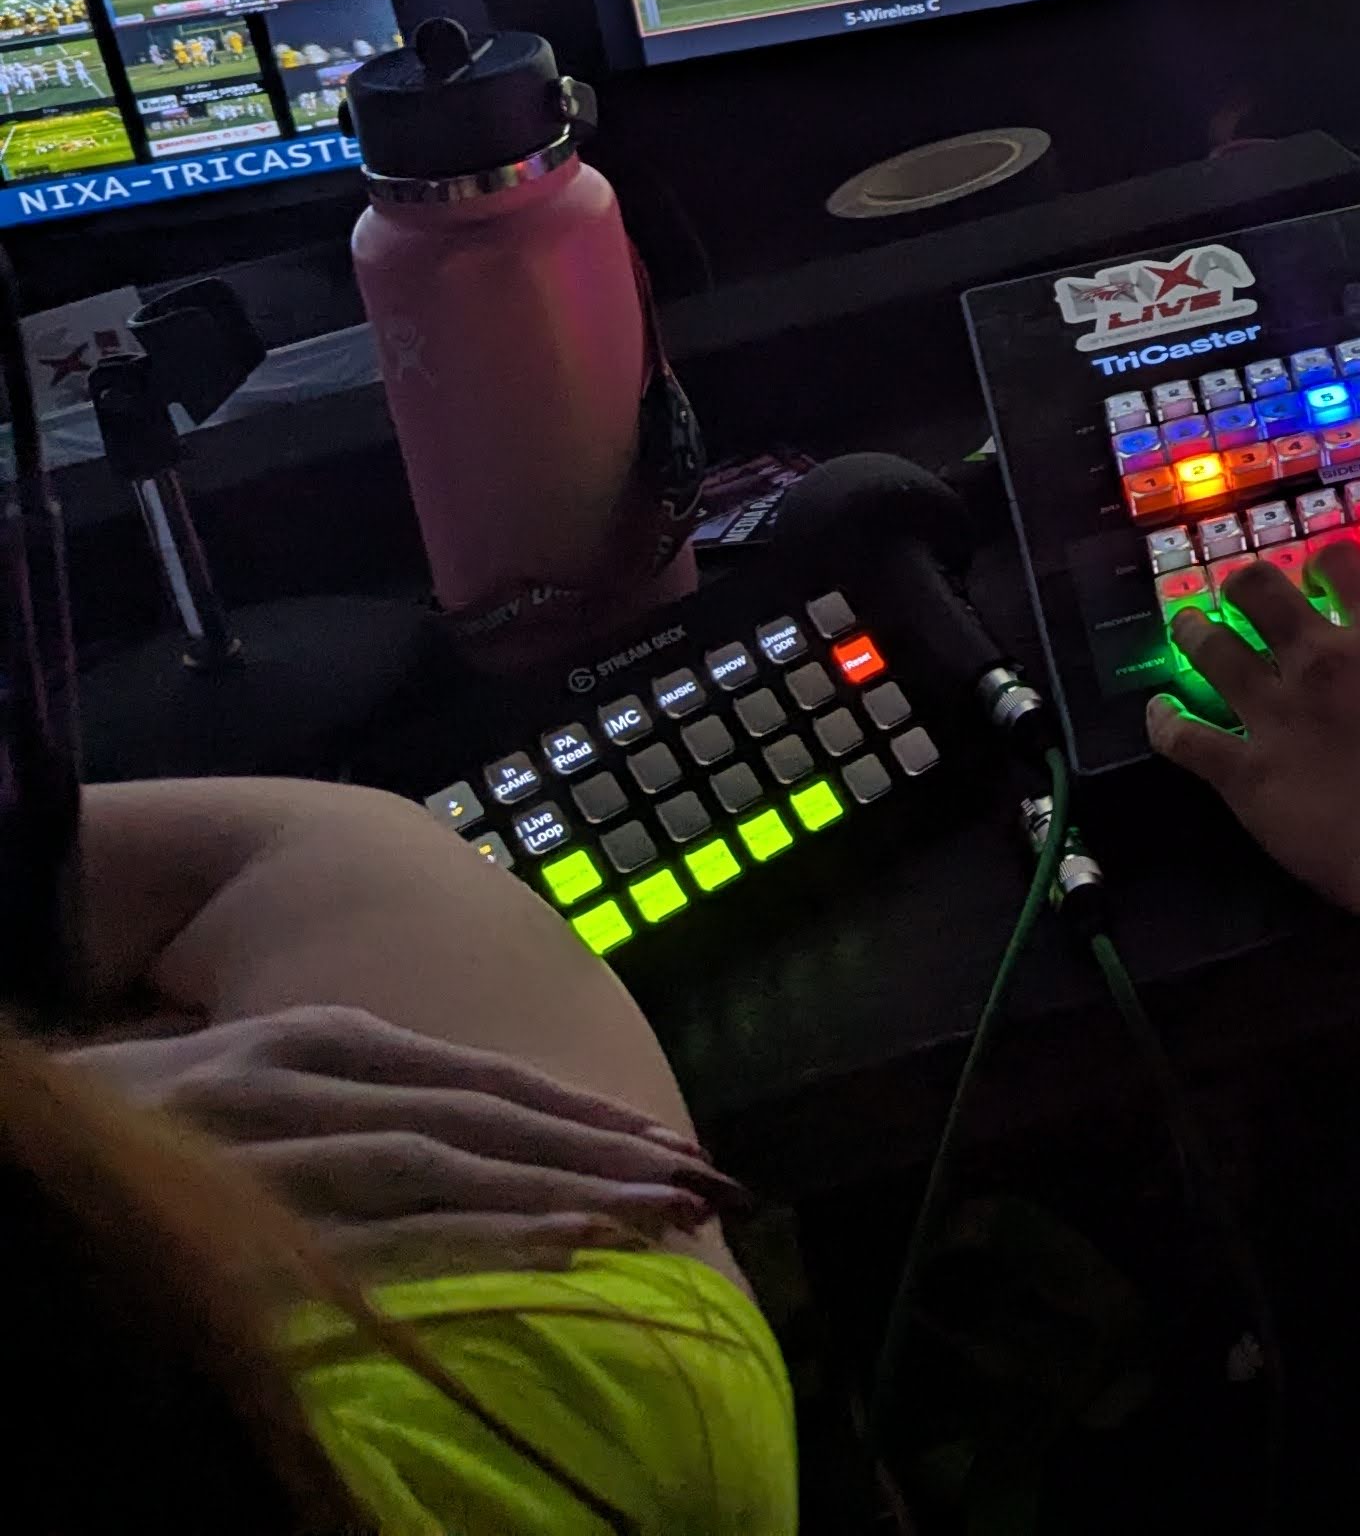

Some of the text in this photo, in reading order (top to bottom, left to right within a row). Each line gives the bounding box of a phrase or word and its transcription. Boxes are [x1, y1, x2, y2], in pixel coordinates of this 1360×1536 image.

[844, 2, 926, 27] 5-Wireless
[1107, 289, 1223, 331] LIVE
[1091, 321, 1263, 379] TriCaster
[1320, 391, 1335, 404] 5
[1191, 464, 1206, 477] 2
[772, 636, 798, 655] DDR
[711, 654, 748, 682] SHOW
[658, 680, 698, 709] MUSIC
[552, 741, 594, 770] Read
[553, 735, 578, 752] PA
[495, 769, 538, 797] GAME
[521, 811, 554, 834] Live
[527, 822, 565, 848] Loop
